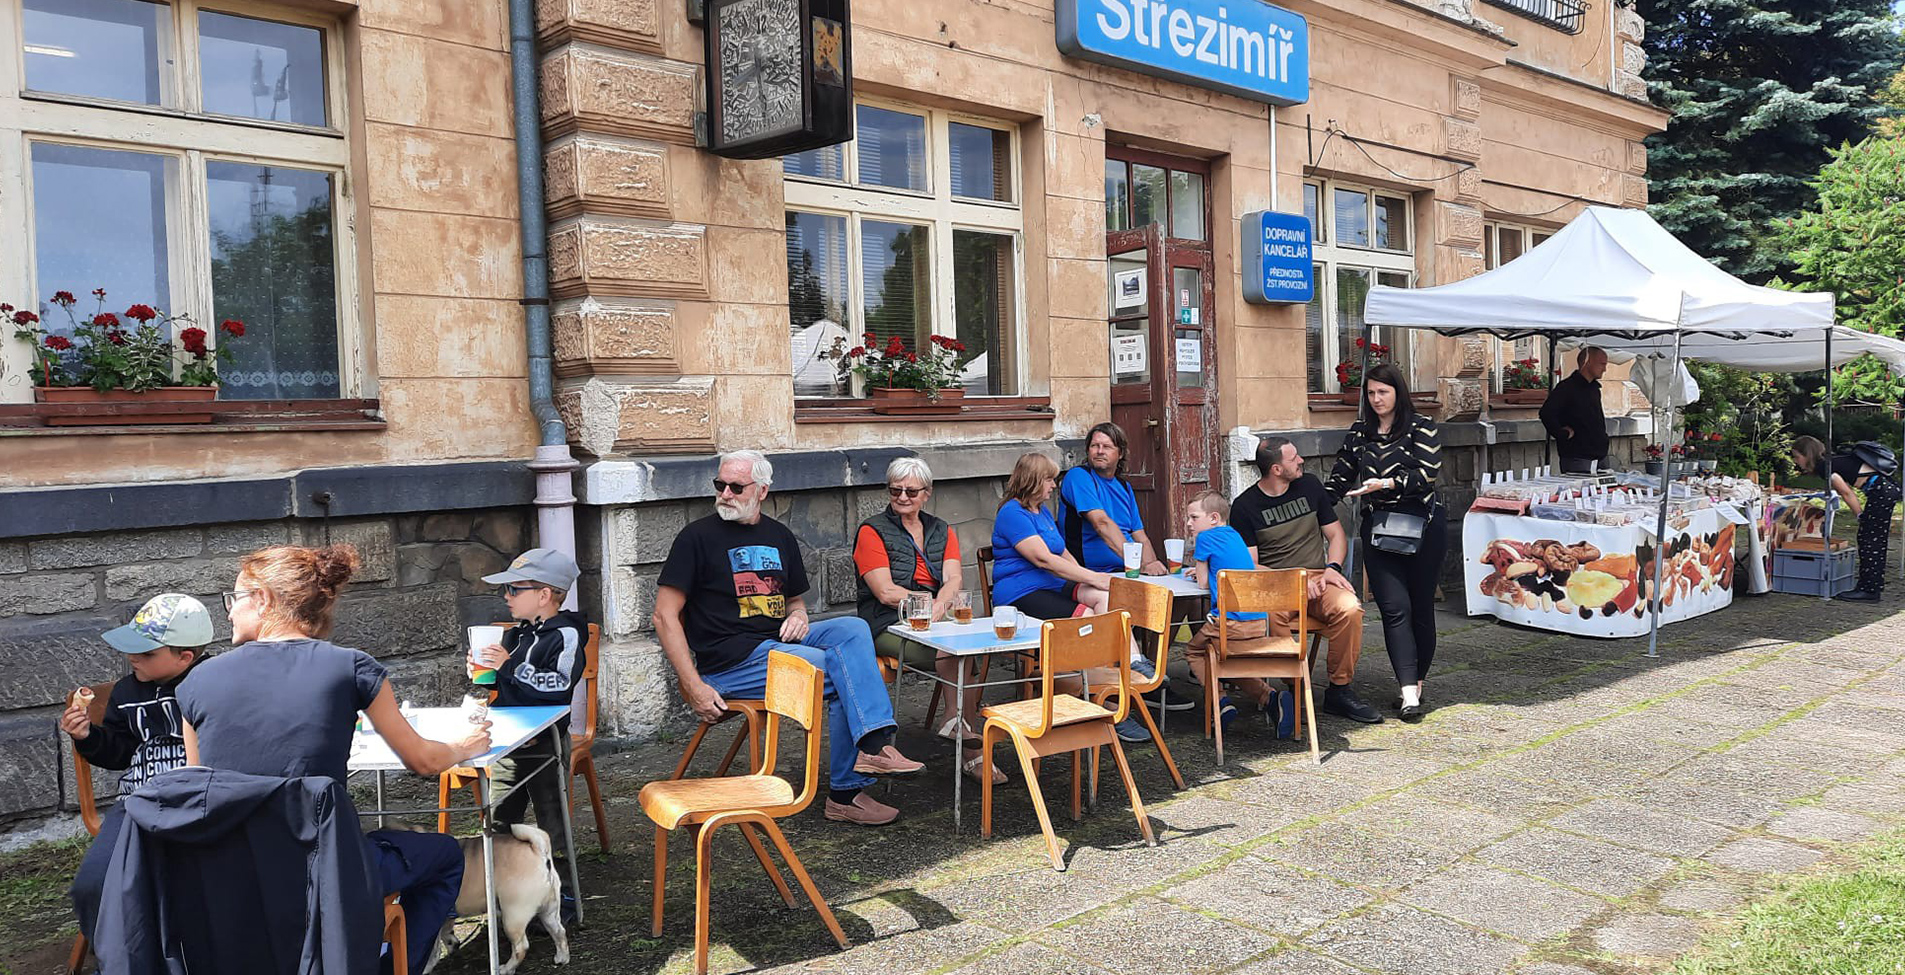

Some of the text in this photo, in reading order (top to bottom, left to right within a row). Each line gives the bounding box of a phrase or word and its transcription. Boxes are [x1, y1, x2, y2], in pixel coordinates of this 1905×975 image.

[1096, 0, 1294, 84] Střezimíř
[1265, 227, 1306, 243] DOPRAVNÍ
[1264, 243, 1308, 259] KANCELÁŘ
[1269, 266, 1304, 279] PŘEDNOSTA
[1261, 496, 1312, 526] PUMA
